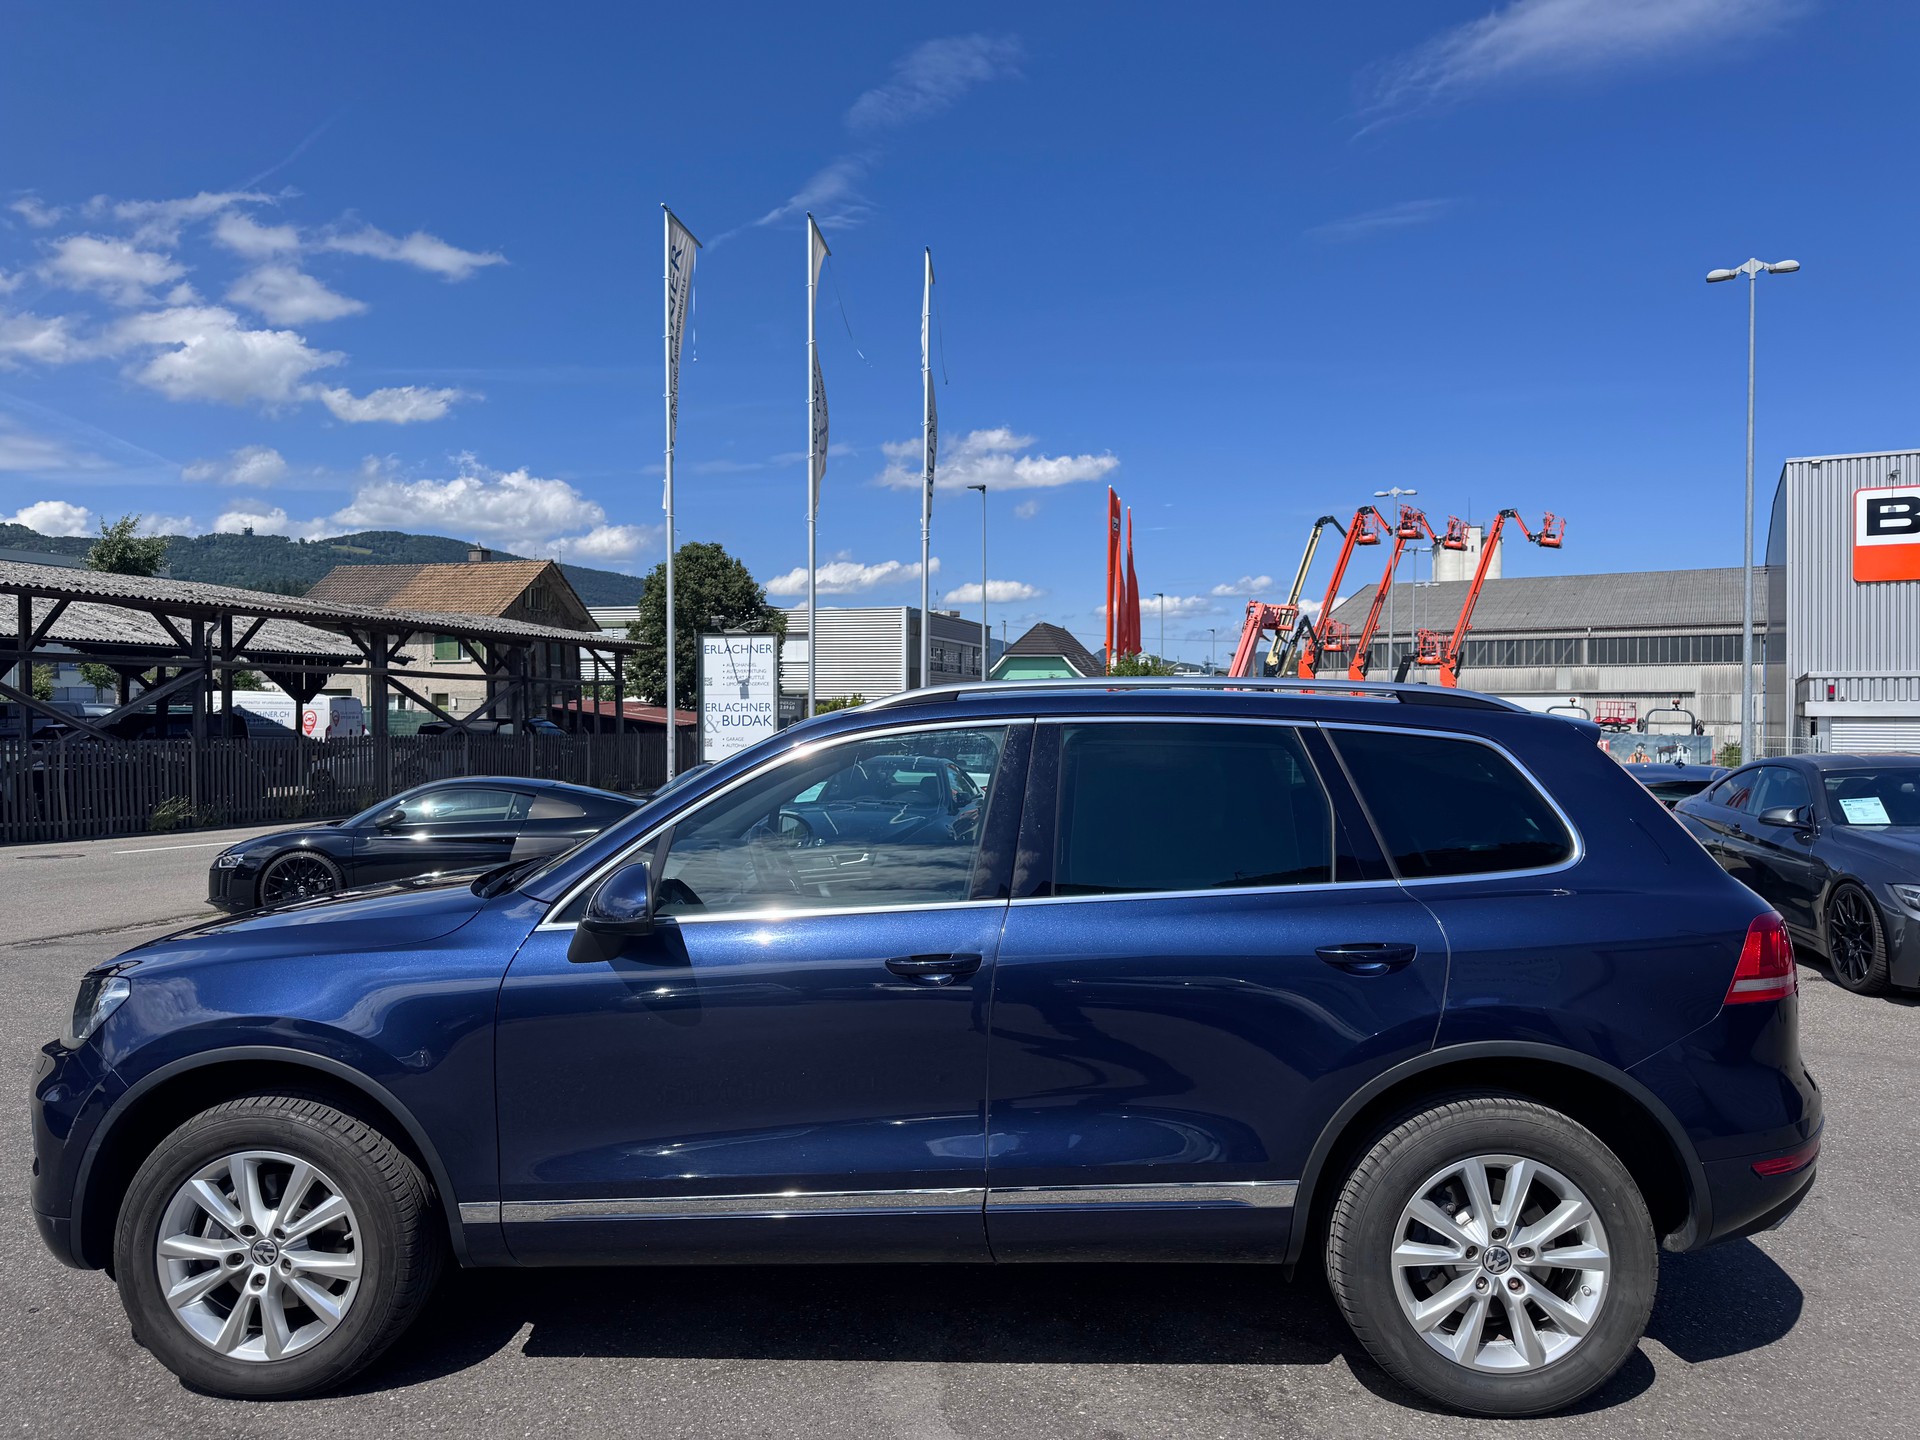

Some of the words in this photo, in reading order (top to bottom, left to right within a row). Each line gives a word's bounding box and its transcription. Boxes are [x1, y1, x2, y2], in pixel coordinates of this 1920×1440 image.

[704, 644, 773, 654] ERLACHNER
[705, 702, 772, 712] ERLACHNER
[703, 714, 721, 733] &
[722, 714, 773, 727] BUDAK
